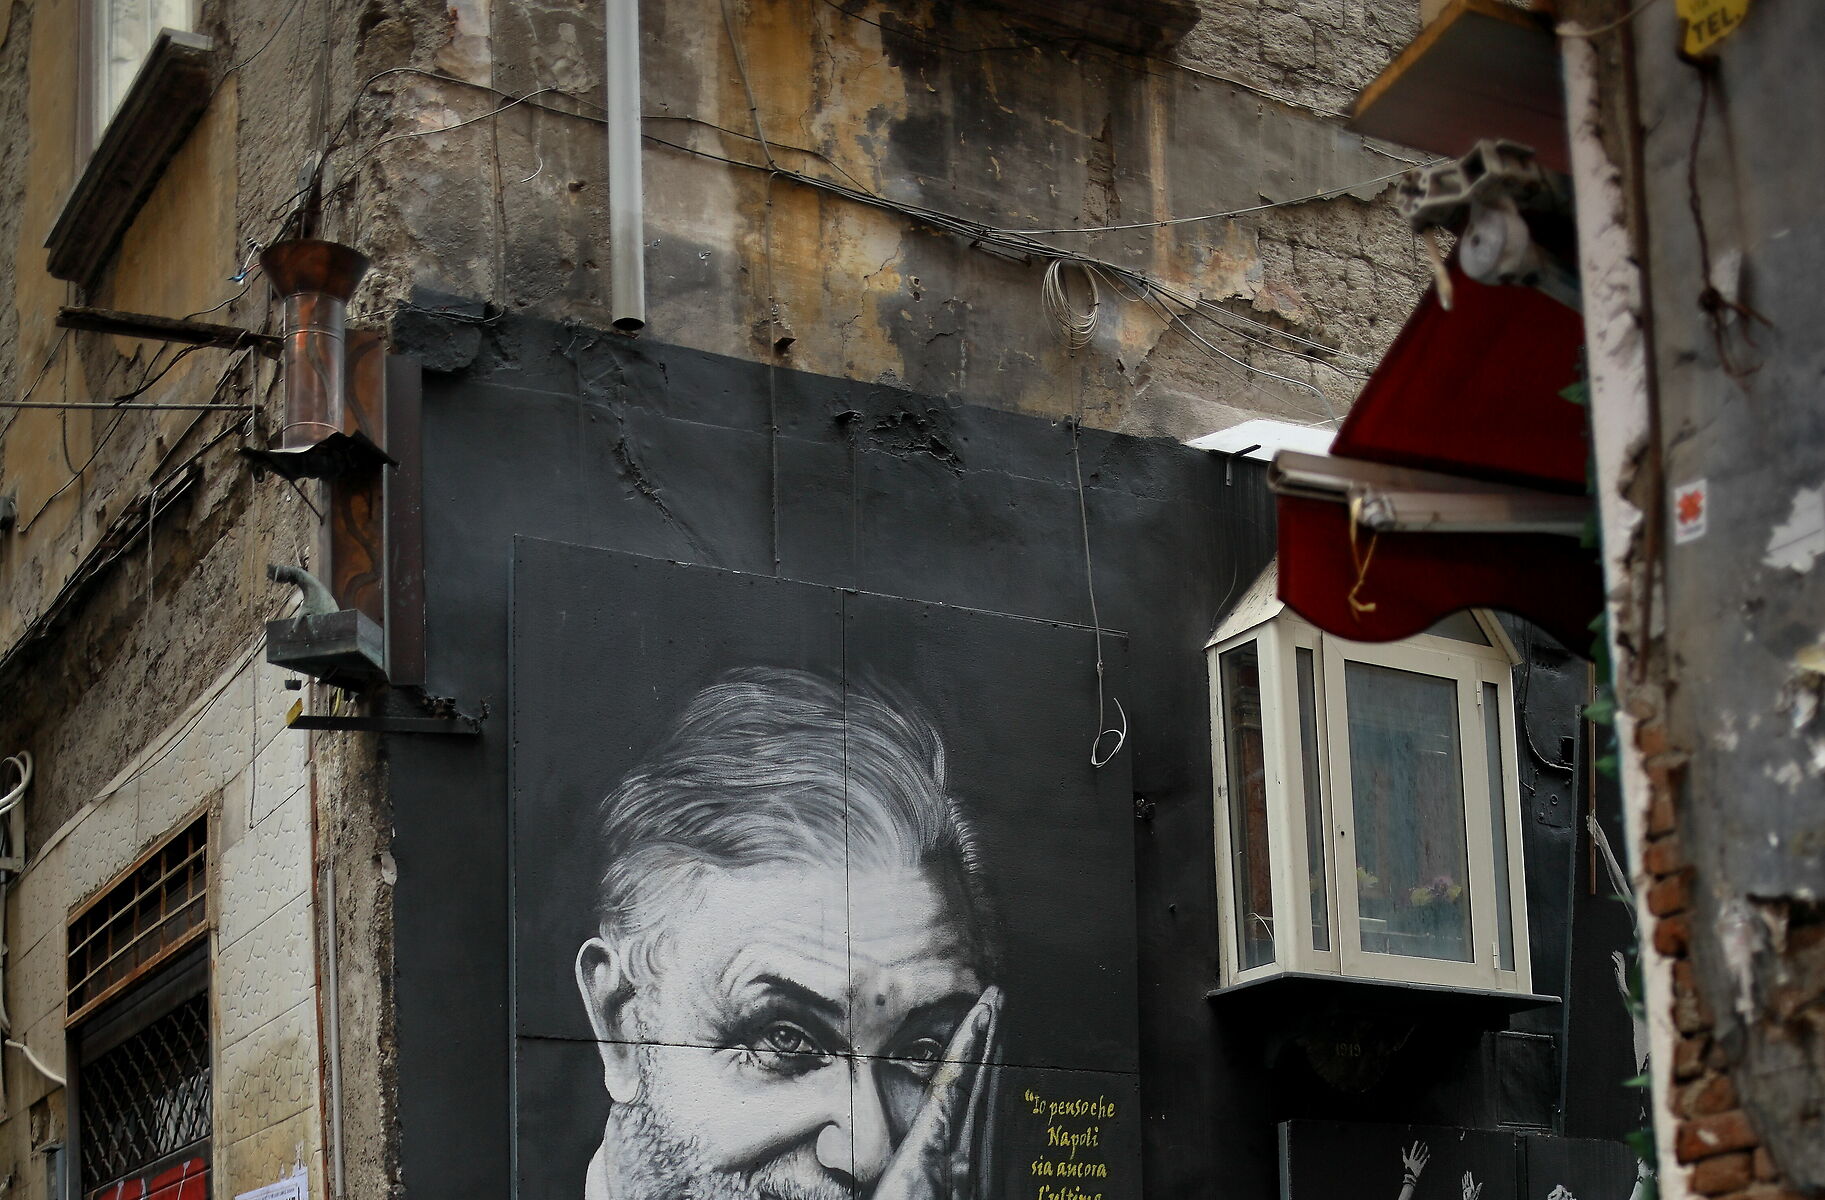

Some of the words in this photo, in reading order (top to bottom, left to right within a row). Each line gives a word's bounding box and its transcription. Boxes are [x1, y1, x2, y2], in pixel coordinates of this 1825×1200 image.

[1047, 1125, 1099, 1160] Napoli
[1031, 1155, 1054, 1176] sia
[1056, 1161, 1108, 1178] ancora
